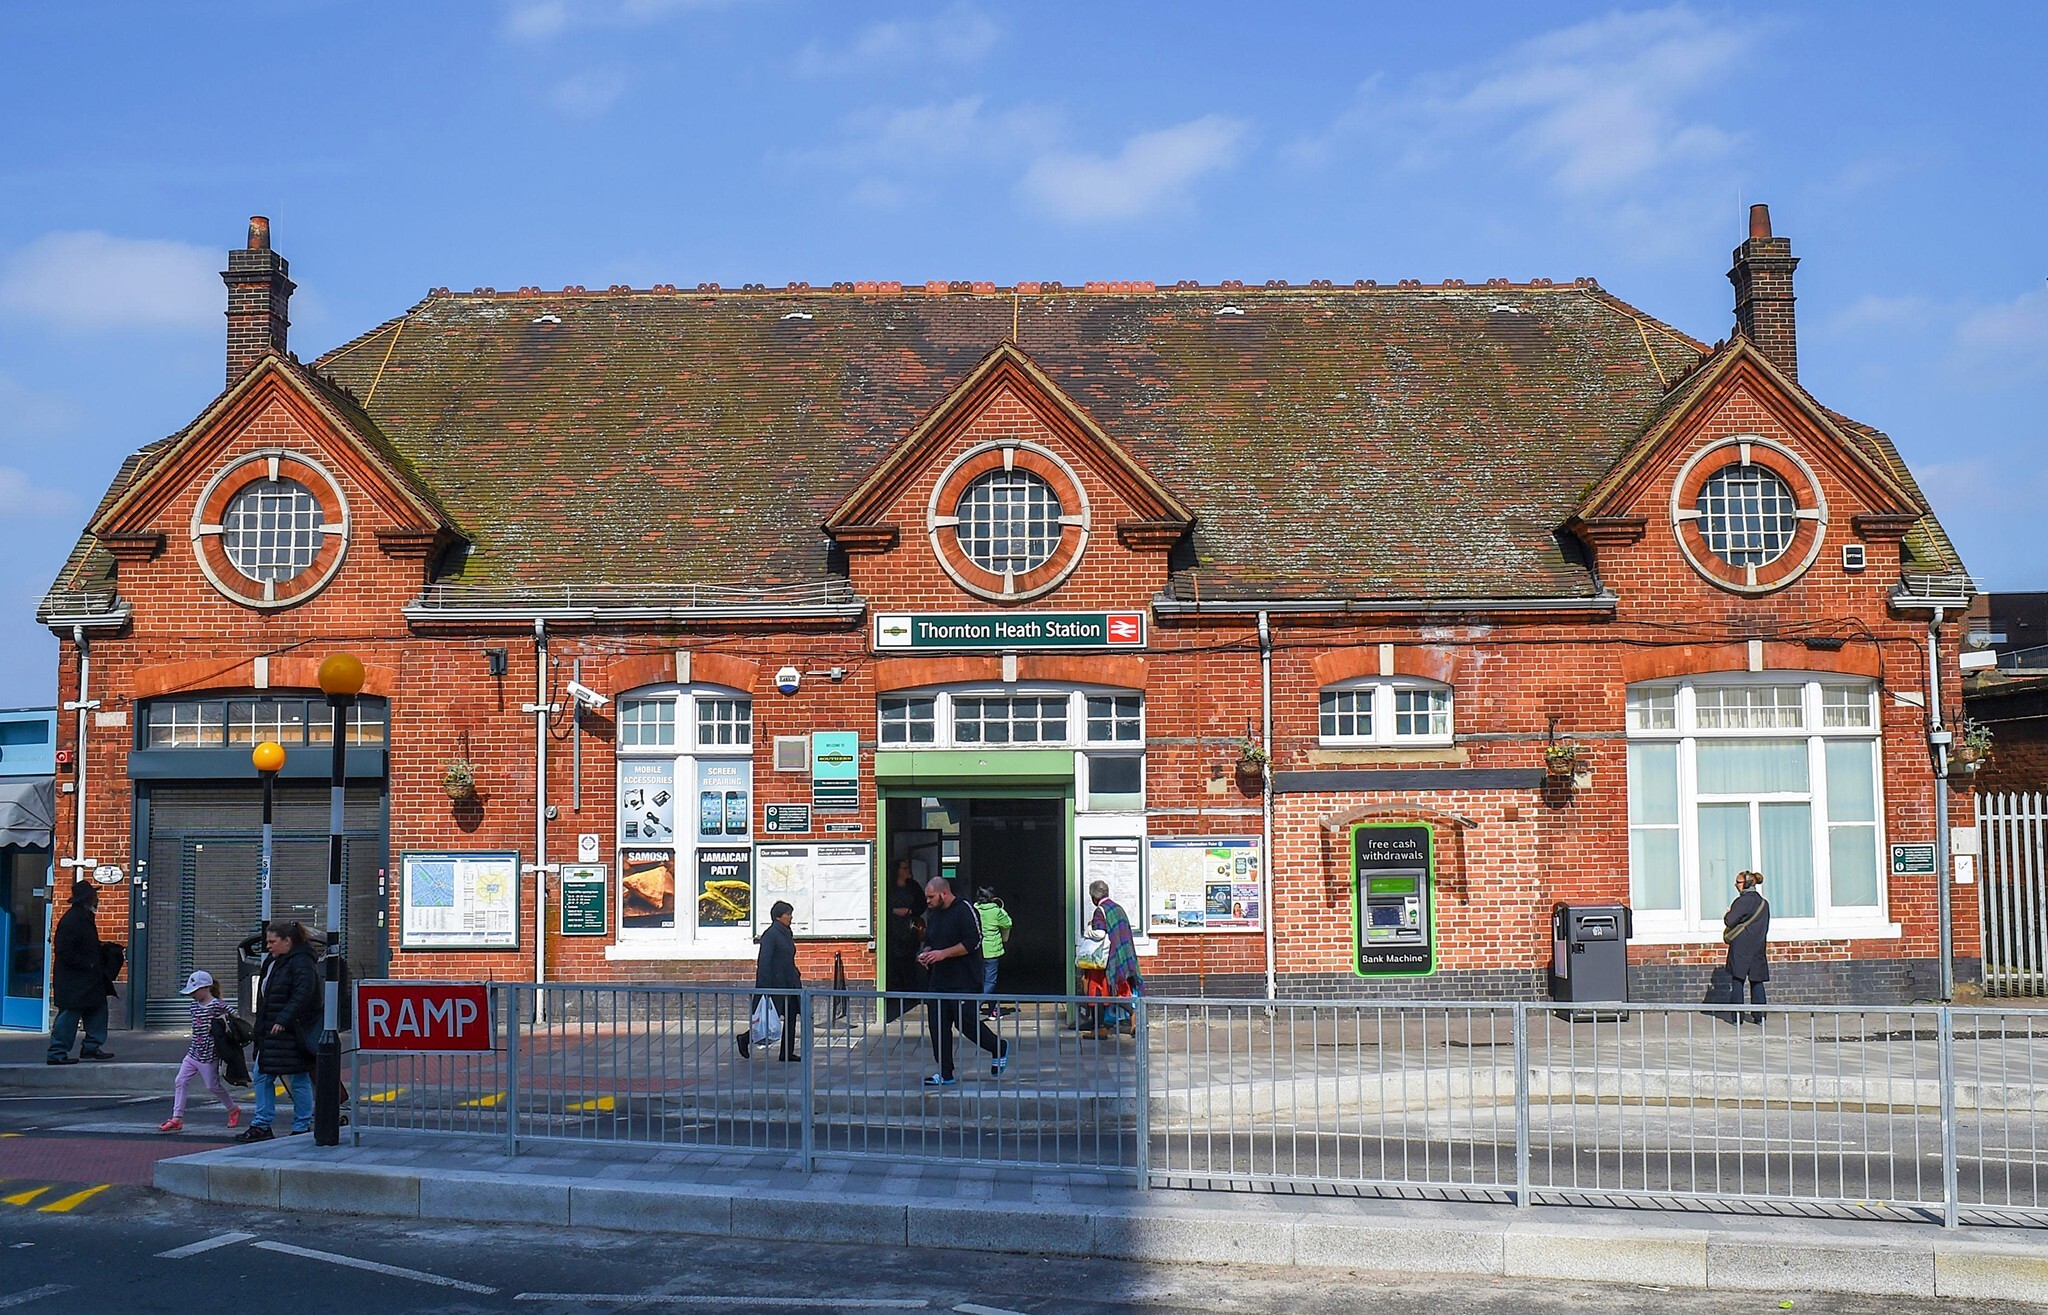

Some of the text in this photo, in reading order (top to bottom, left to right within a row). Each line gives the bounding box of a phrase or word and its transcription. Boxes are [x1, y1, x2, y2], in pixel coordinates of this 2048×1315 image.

[918, 621, 1100, 638] Thornton Heath Station
[634, 765, 663, 774] MOBILE
[707, 767, 737, 775] SCREEN
[623, 776, 673, 784] ACCESSORIES
[703, 778, 742, 786] REPAIRING
[1368, 839, 1416, 849] free cash
[628, 851, 670, 862] SAMOSA
[700, 852, 748, 863] JAMAICAN
[1362, 850, 1424, 861] withdrawals
[710, 865, 739, 876] PATTY
[1362, 955, 1384, 963] Bank
[367, 998, 478, 1038] RAMP
